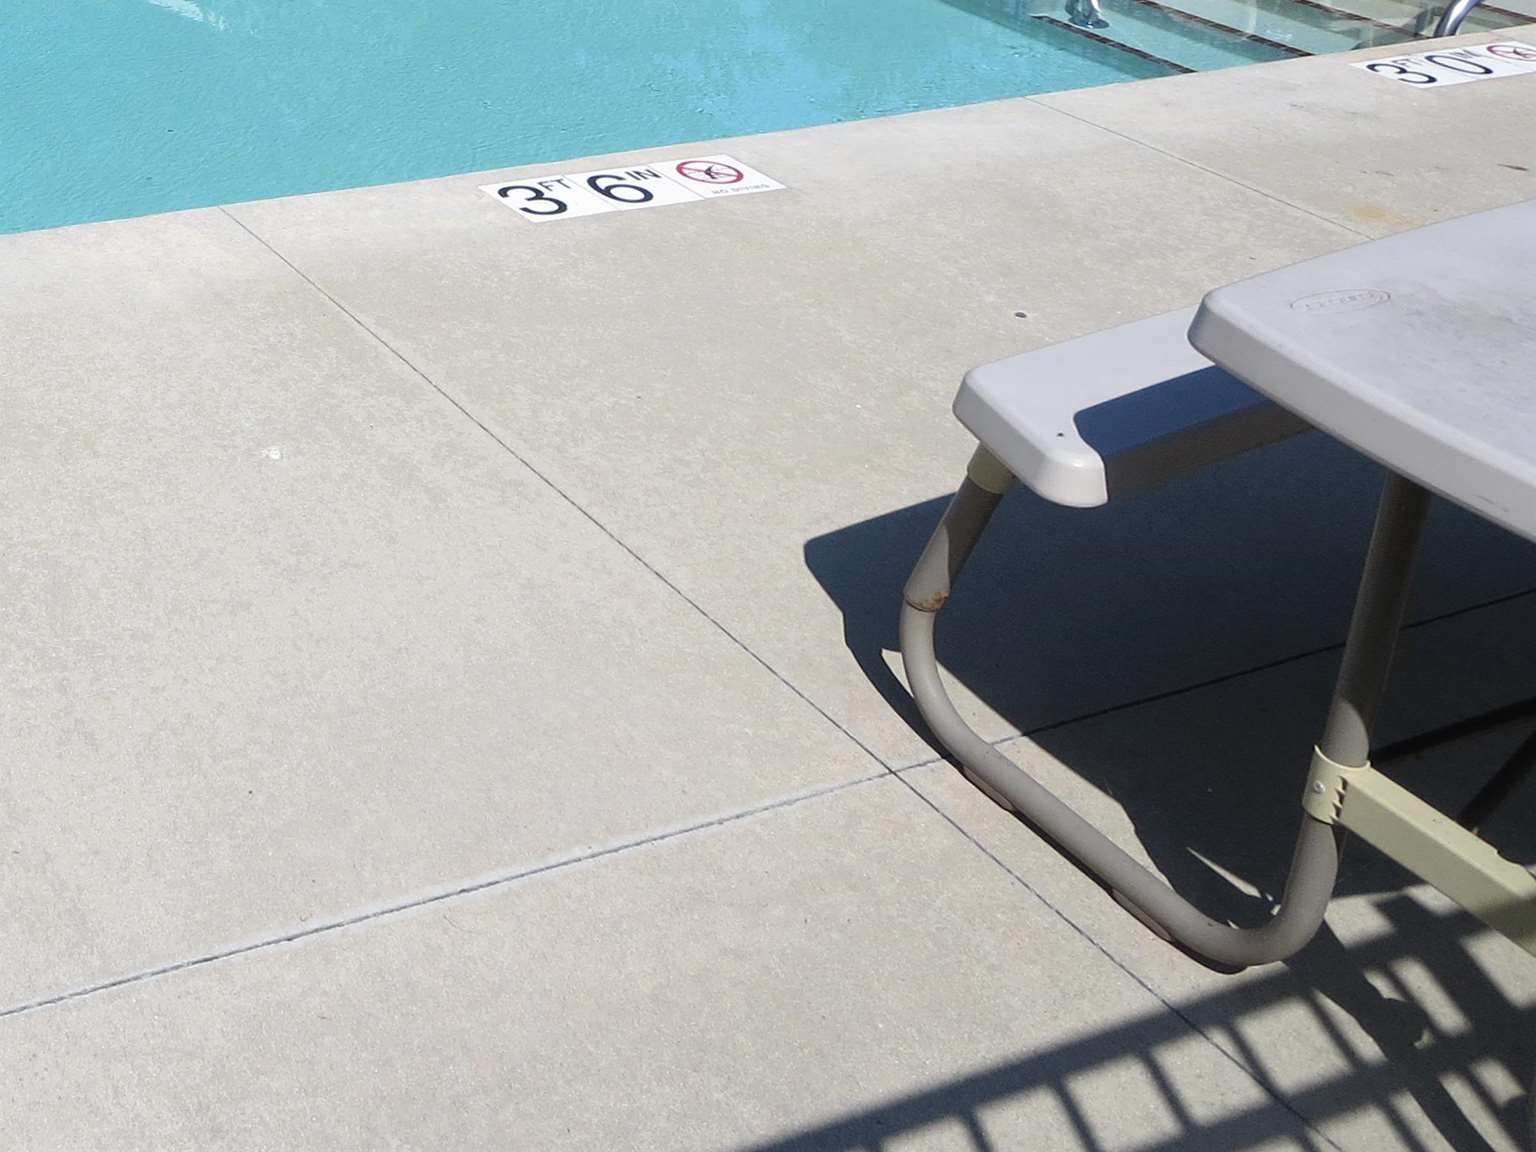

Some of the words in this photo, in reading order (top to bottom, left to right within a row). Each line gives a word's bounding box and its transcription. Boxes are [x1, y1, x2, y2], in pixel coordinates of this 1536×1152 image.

[1365, 63, 1438, 84] 3
[1424, 55, 1494, 75] 0
[497, 185, 568, 215] 3
[538, 177, 572, 192] FT
[586, 174, 654, 204] 6
[626, 167, 662, 181] IN
